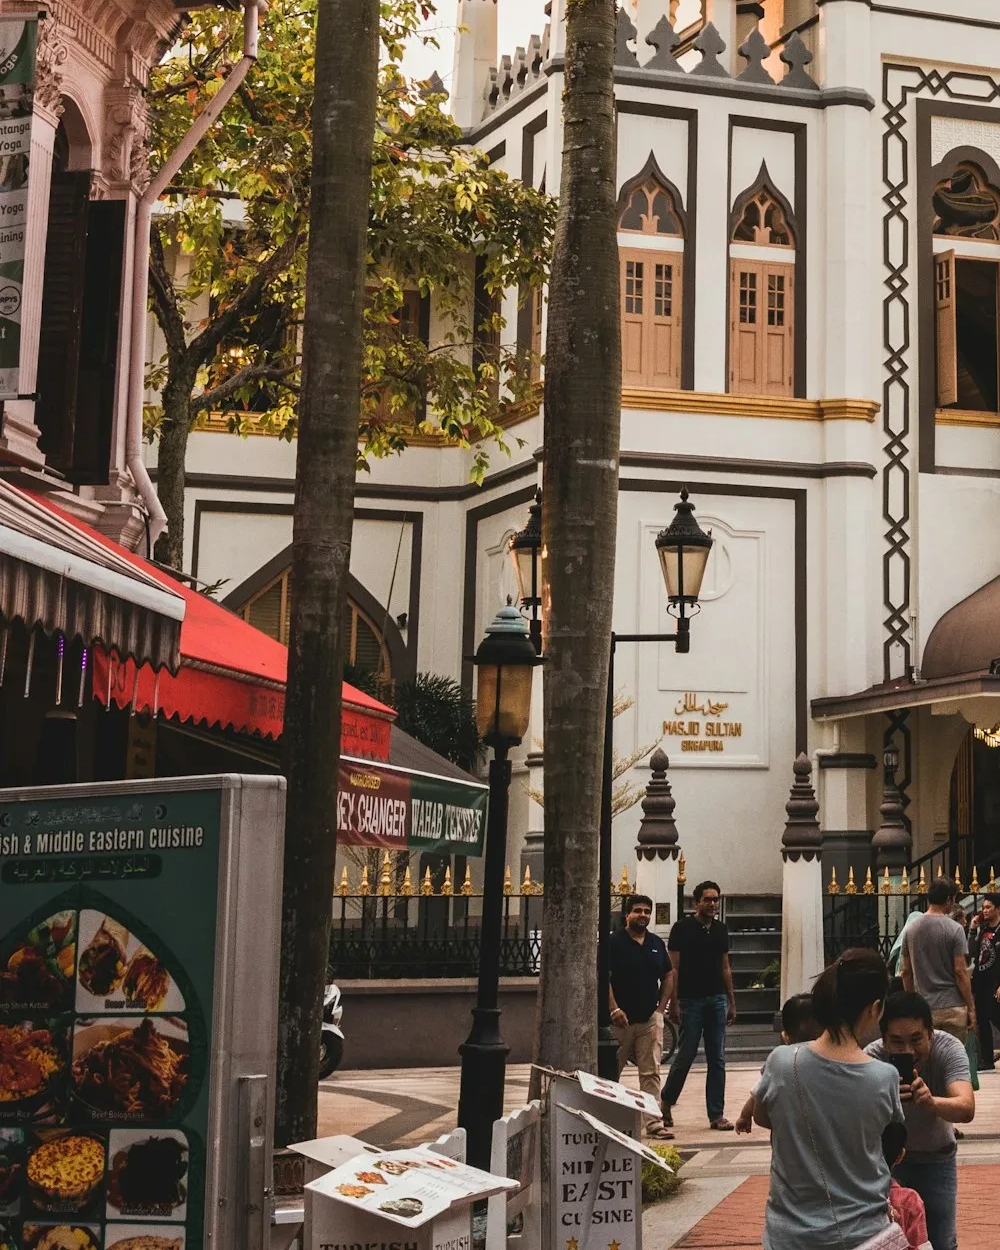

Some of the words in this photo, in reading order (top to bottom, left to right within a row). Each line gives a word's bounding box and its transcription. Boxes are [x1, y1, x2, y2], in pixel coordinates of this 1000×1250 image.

[1, 203, 24, 217] Yoga
[662, 720, 700, 736] MASJID
[705, 721, 742, 737] SULTAN
[681, 740, 724, 752] SINGAPURA
[357, 793, 407, 837] CHANGER
[411, 798, 444, 839] WAHAB
[24, 835, 31, 855] &
[36, 829, 85, 854] Middle
[89, 826, 144, 851] Eastern
[150, 823, 204, 848] Cuisine
[561, 1209, 633, 1226] CUSINE
